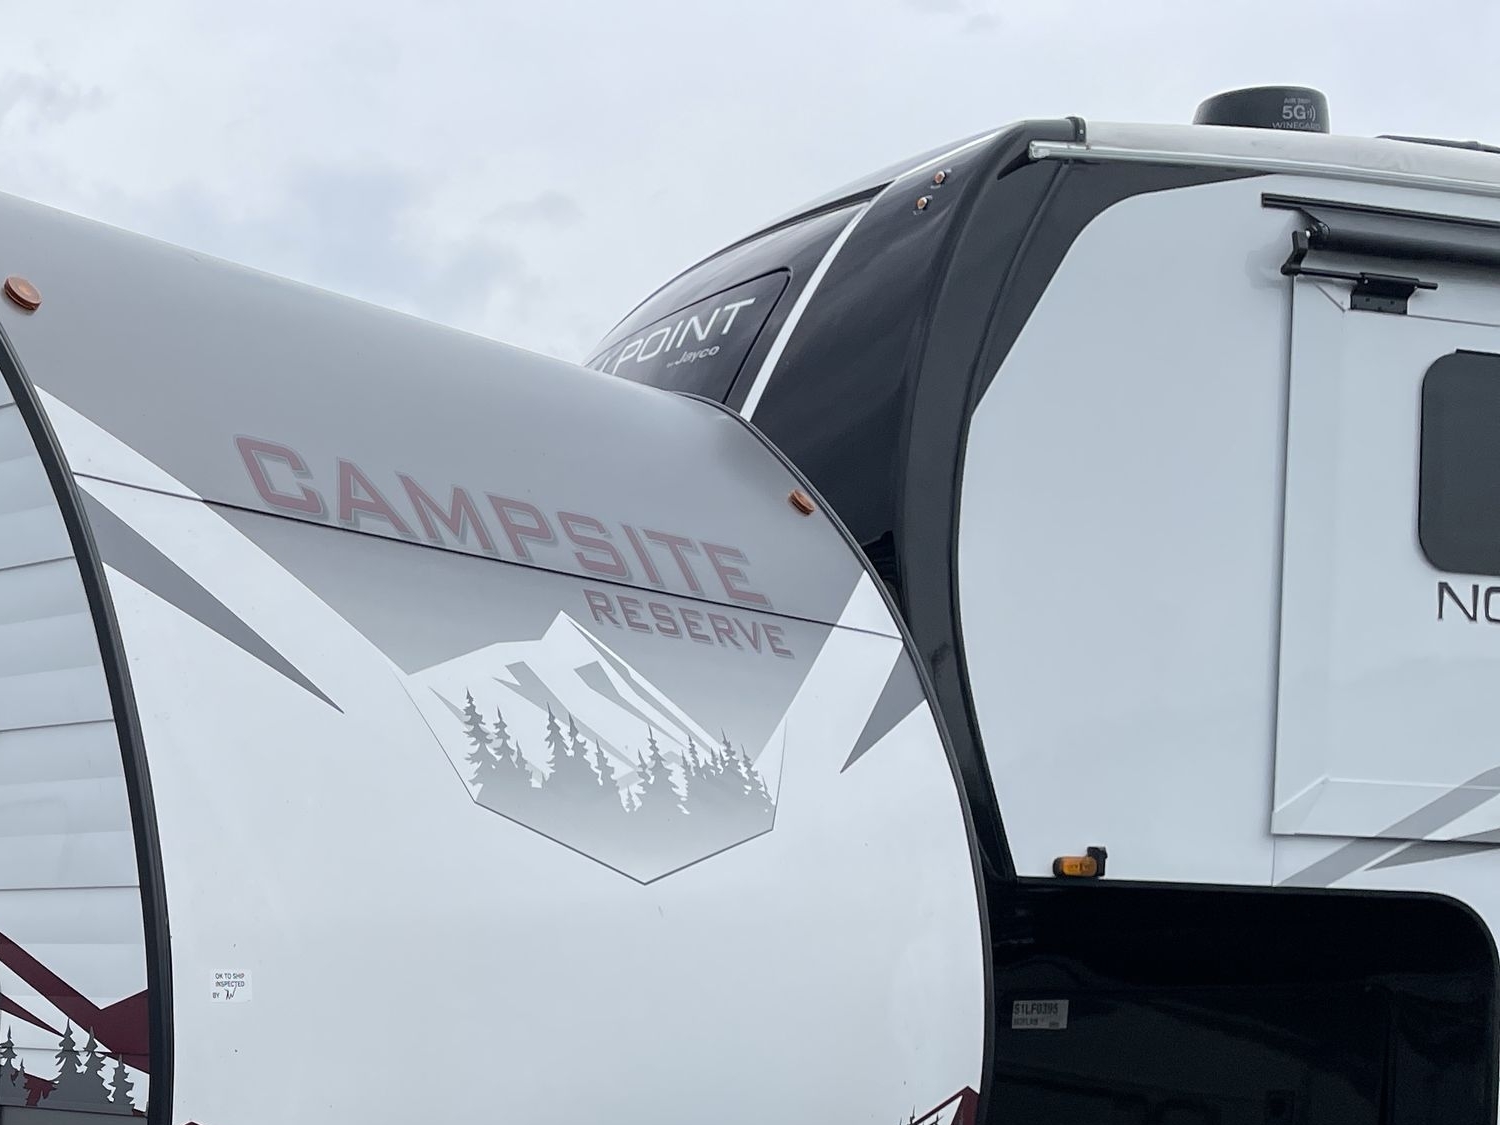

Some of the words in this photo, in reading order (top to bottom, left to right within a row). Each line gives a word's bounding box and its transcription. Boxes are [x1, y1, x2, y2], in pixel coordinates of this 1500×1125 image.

[1282, 104, 1307, 120] 5G
[674, 345, 720, 366] Jayco
[233, 433, 773, 607] CAMPSITE
[583, 588, 795, 659] RESERVE
